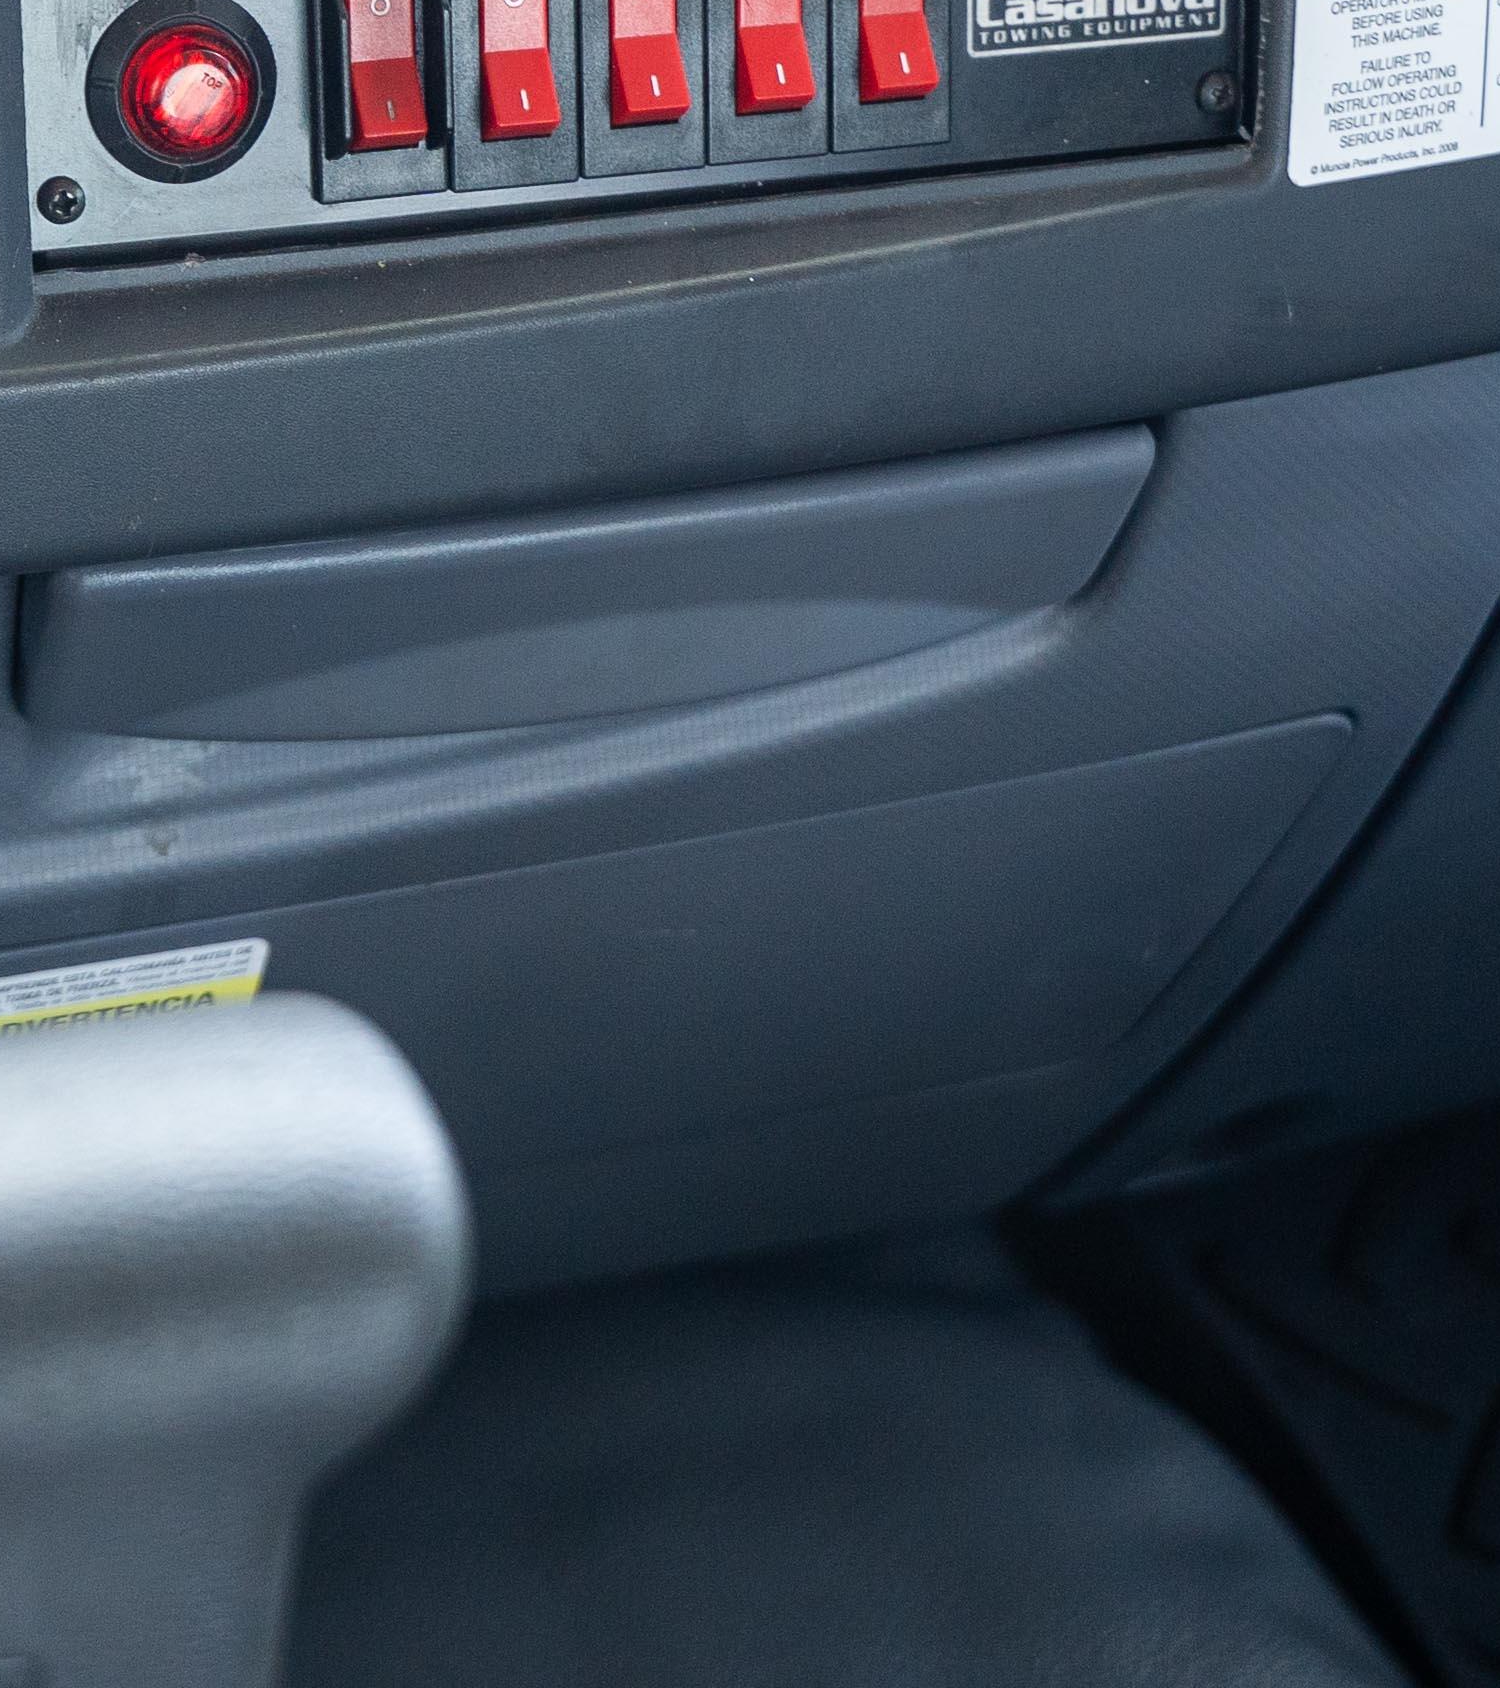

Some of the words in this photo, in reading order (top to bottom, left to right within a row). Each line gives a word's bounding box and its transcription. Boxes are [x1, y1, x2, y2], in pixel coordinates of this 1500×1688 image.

[979, 25, 1072, 45] TOWING
[1083, 11, 1217, 37] EQUIPMENT
[1352, 12, 1400, 29] BEFORE
[1405, 5, 1444, 21] USING
[1352, 32, 1379, 48] THIS
[1361, 54, 1410, 74] FAILURE
[1415, 51, 1431, 65] TO
[201, 72, 224, 90] TOP
[1332, 77, 1384, 96] FOLLOW
[1388, 65, 1457, 87] OPERATING
[1324, 90, 1416, 115] INSTRUCTIONS
[1420, 82, 1462, 99] COULD
[1329, 114, 1376, 132] RESULT
[1380, 111, 1391, 124] IN
[1395, 103, 1434, 122] DEATH
[1438, 100, 1455, 114] OR
[1339, 129, 1394, 149] SERIOUS
[1352, 156, 1379, 170] Power
